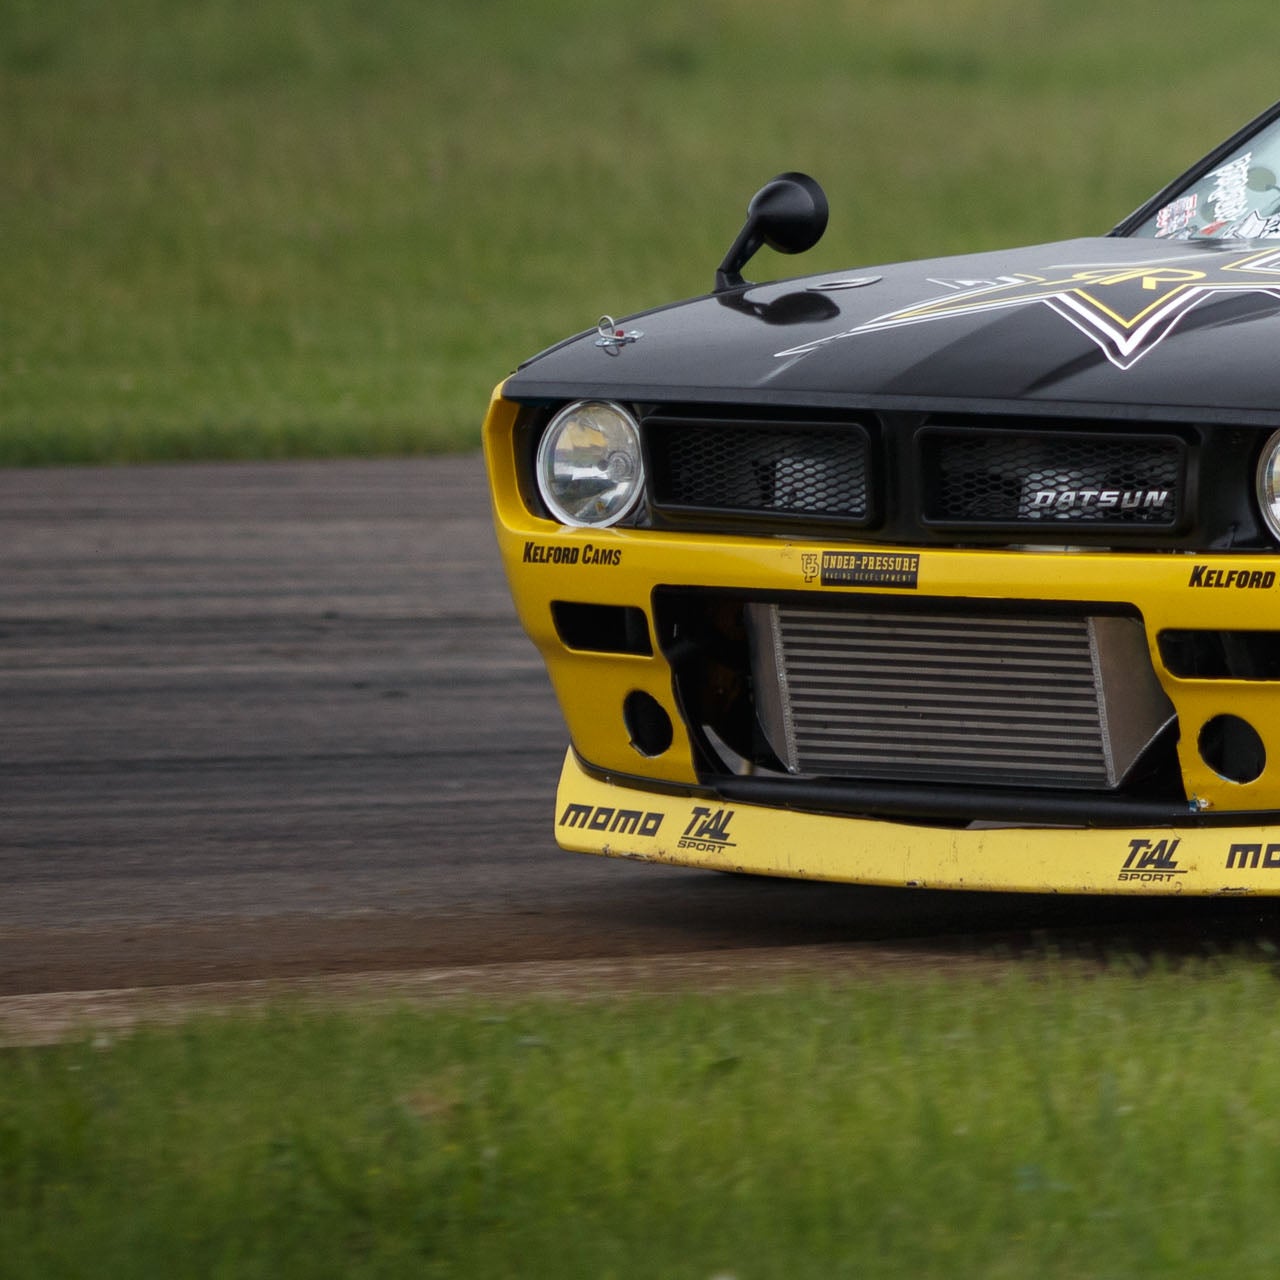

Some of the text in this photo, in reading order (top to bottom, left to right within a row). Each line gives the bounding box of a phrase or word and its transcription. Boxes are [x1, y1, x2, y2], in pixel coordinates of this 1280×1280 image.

[1033, 490, 1168, 509] DATSUN
[823, 554, 918, 572] UNDER-PRESSURE
[677, 839, 726, 854] SPORT
[1117, 872, 1175, 883] SPORT
